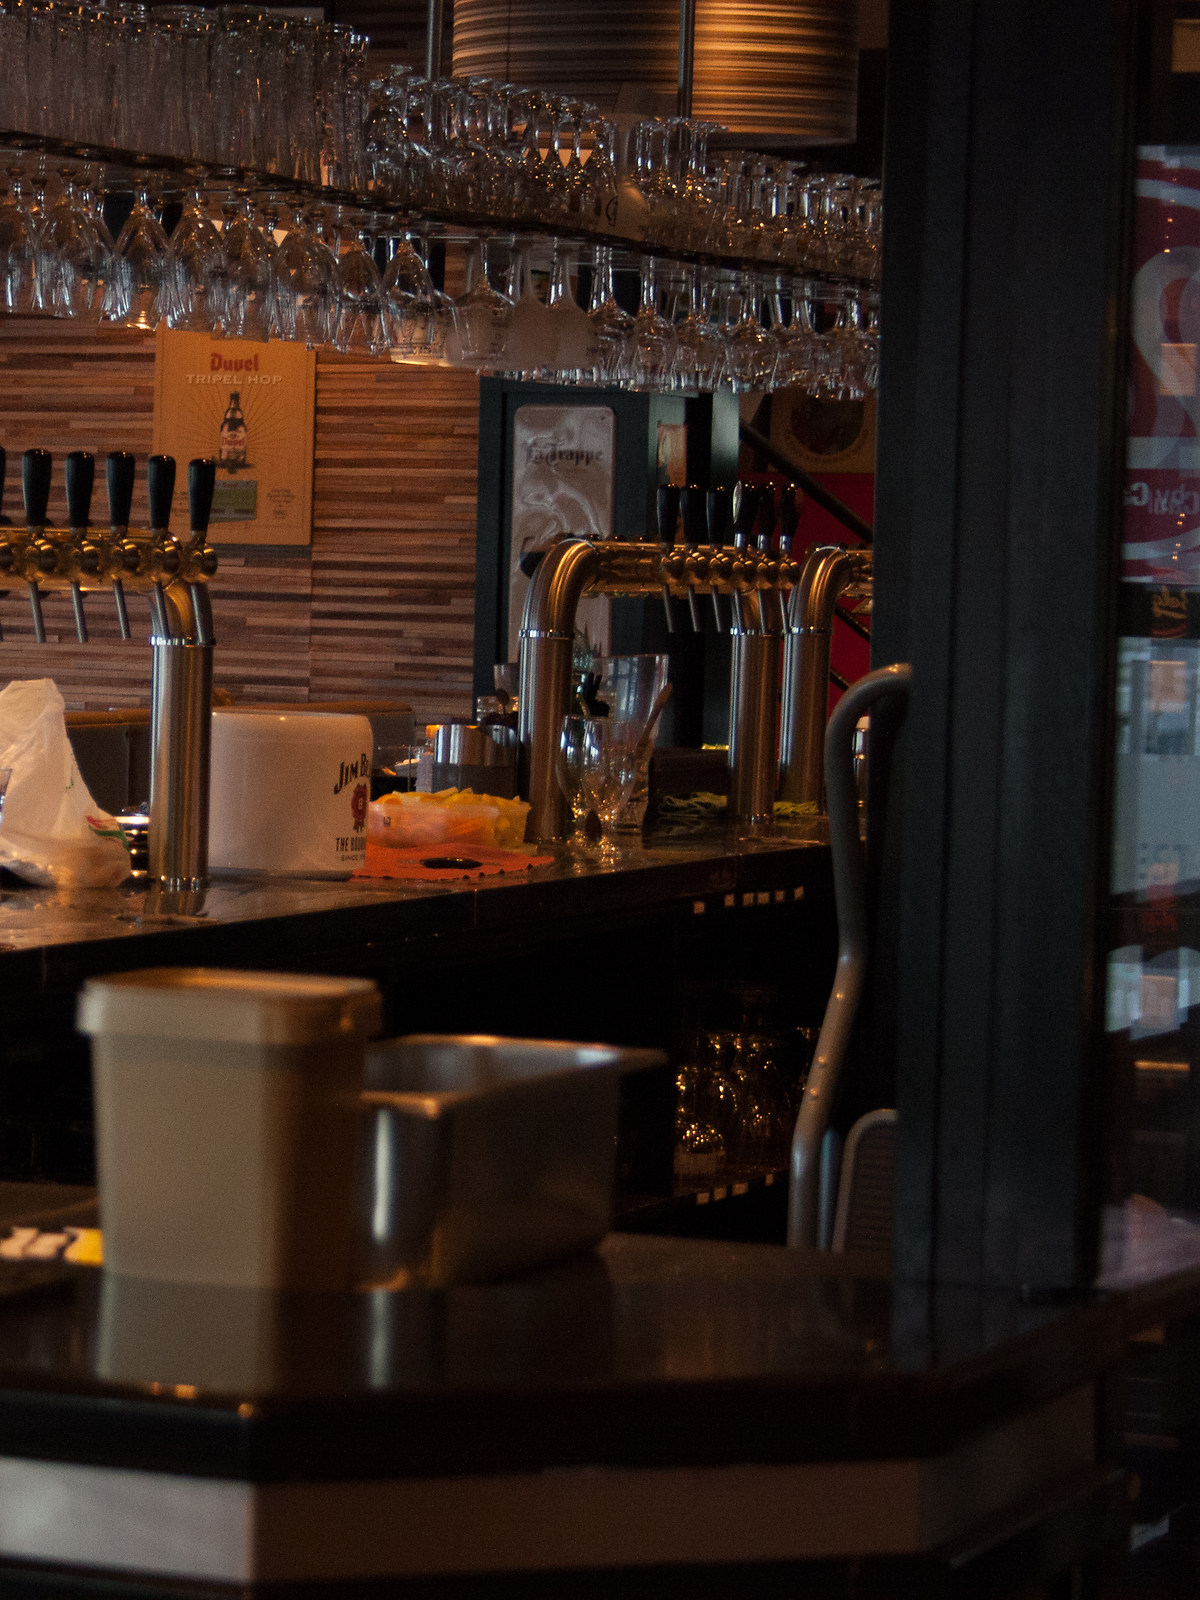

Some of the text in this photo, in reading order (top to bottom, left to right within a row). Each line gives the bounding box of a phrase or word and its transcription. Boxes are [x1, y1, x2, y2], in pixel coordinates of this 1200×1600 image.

[210, 352, 259, 373] Duvel
[185, 373, 283, 386] TRIPEL HOP
[335, 837, 349, 852] THE
